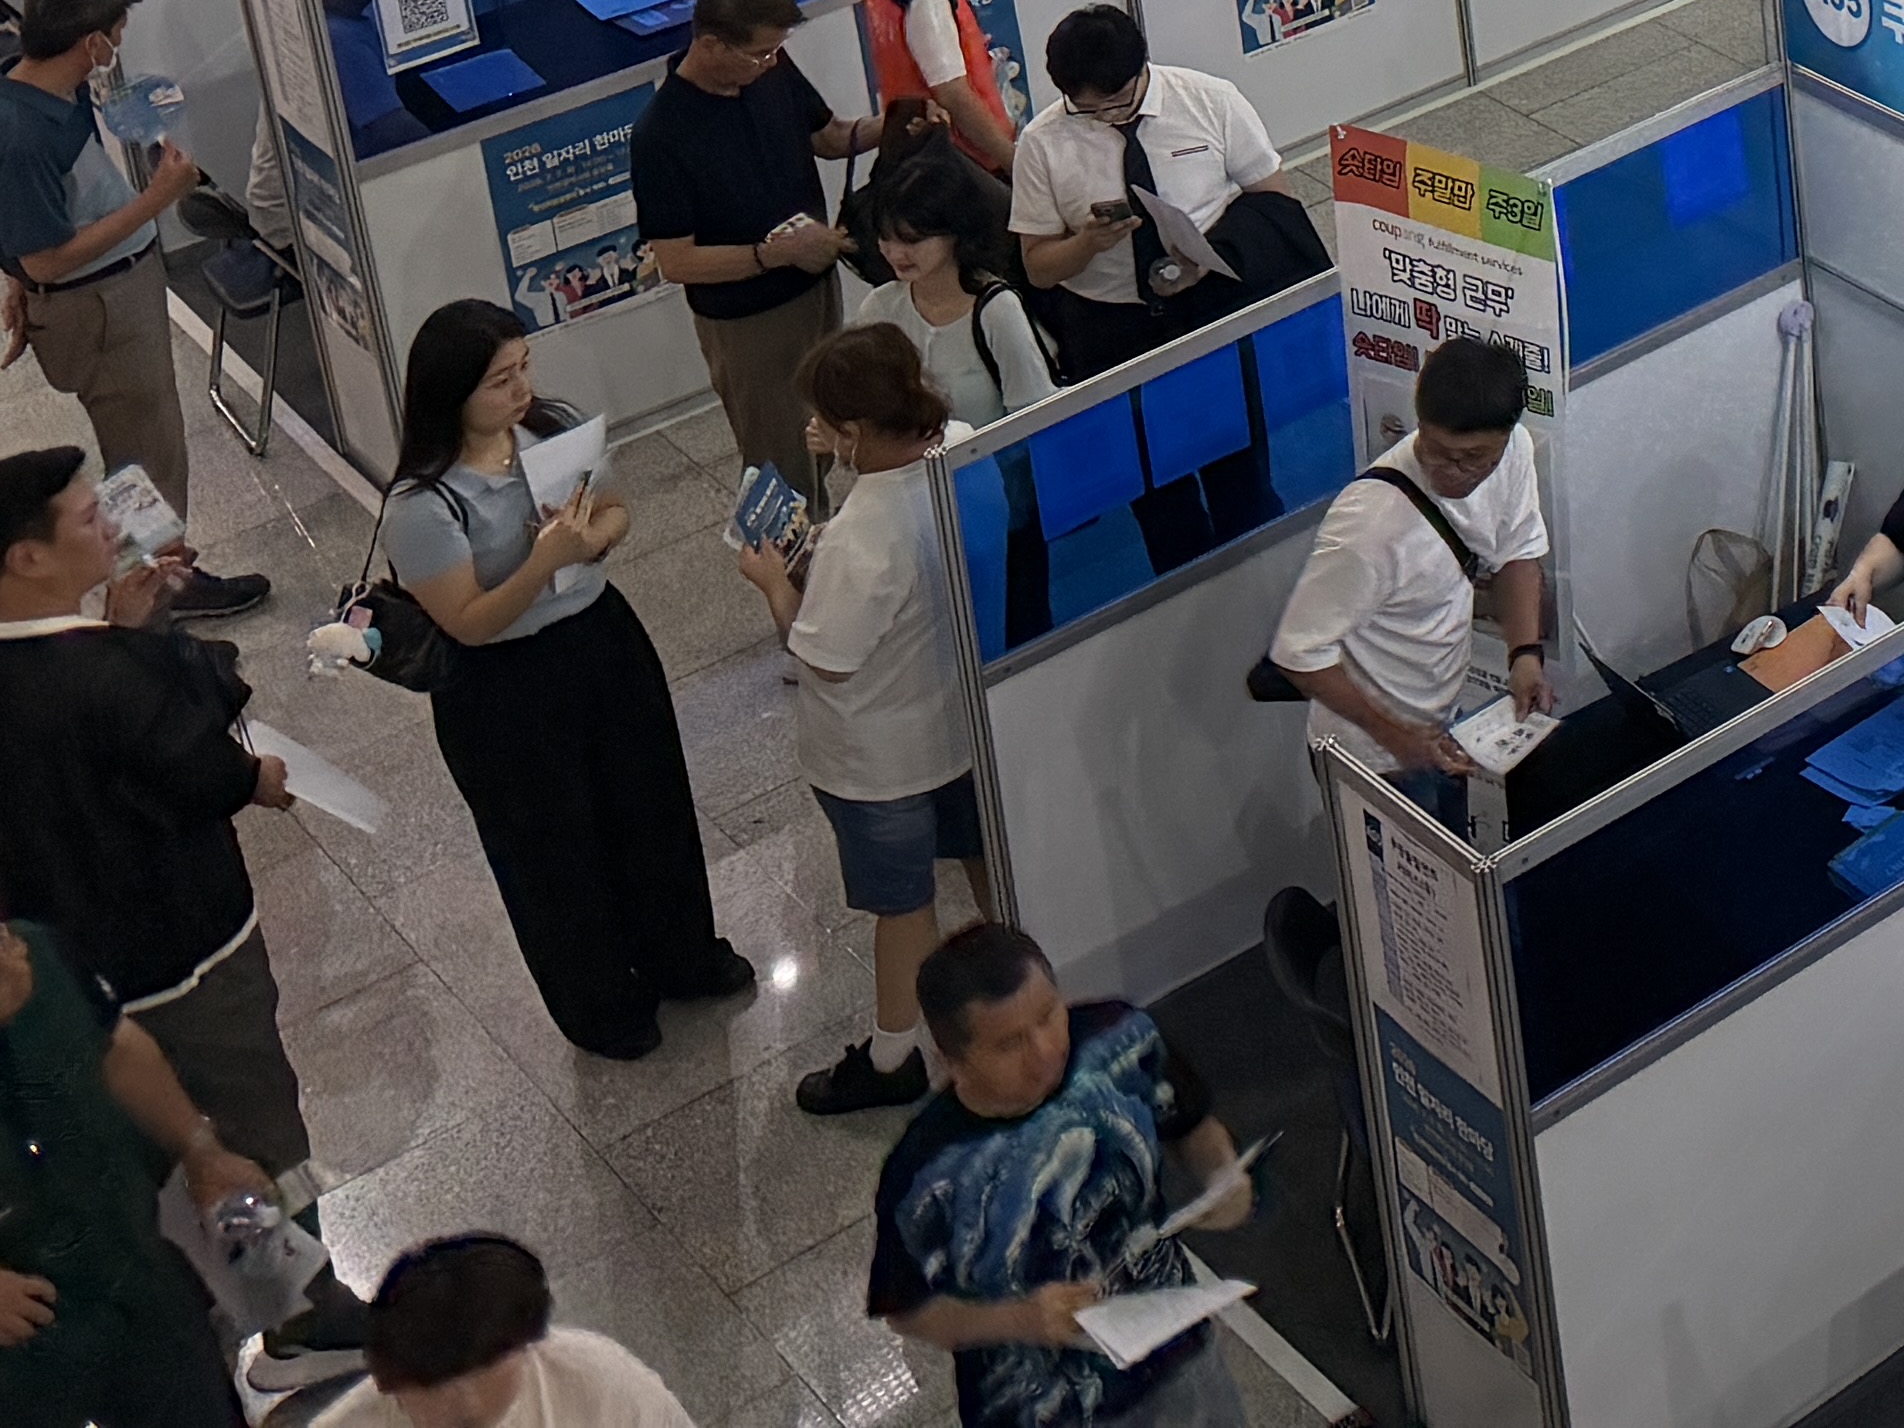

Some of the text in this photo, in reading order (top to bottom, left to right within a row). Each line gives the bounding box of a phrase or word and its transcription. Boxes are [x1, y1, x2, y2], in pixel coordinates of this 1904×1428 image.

[506, 157, 540, 181] 인천
[542, 139, 591, 169] 일자리
[1337, 147, 1544, 232] 숏타임 주말만 주3일
[1351, 288, 1411, 329] 나에게
[1413, 298, 1441, 340] 딱
